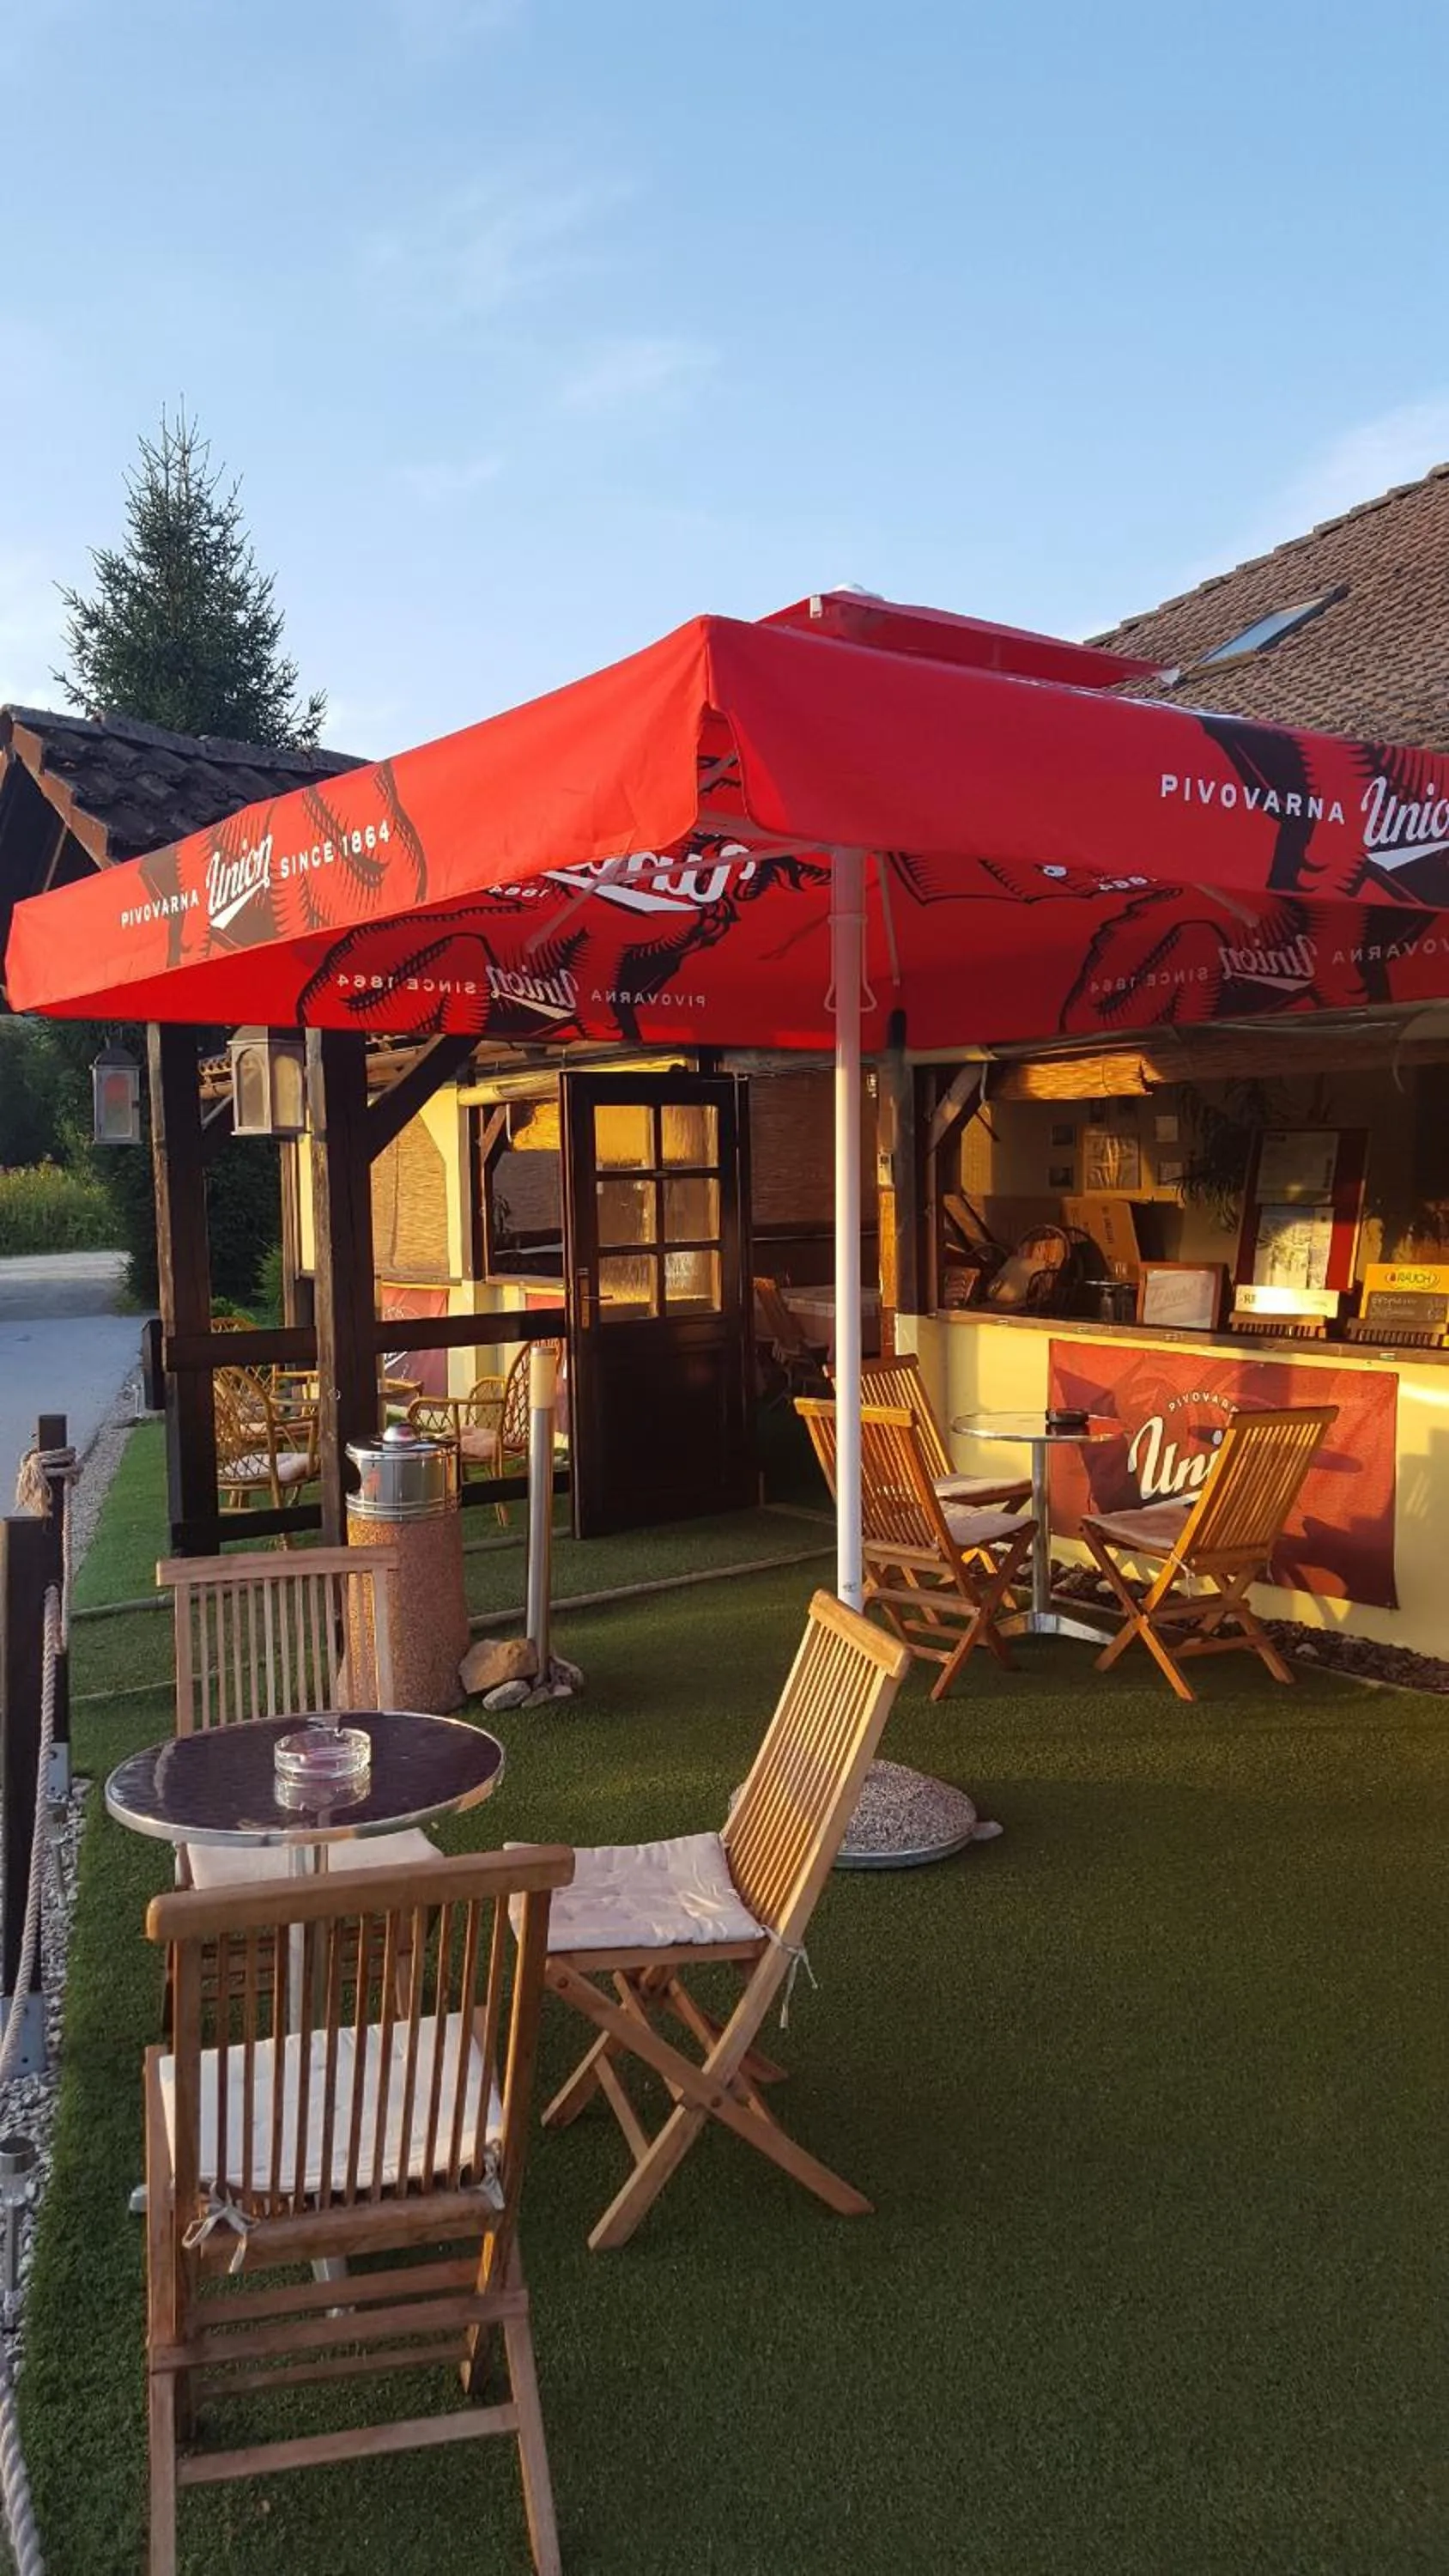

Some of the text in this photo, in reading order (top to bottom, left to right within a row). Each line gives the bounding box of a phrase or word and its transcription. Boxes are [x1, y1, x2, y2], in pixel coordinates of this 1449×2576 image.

[1161, 774, 1449, 848] PIVOVARNA Unio
[121, 819, 391, 928] PIVOVARNA Union SINCE 1864
